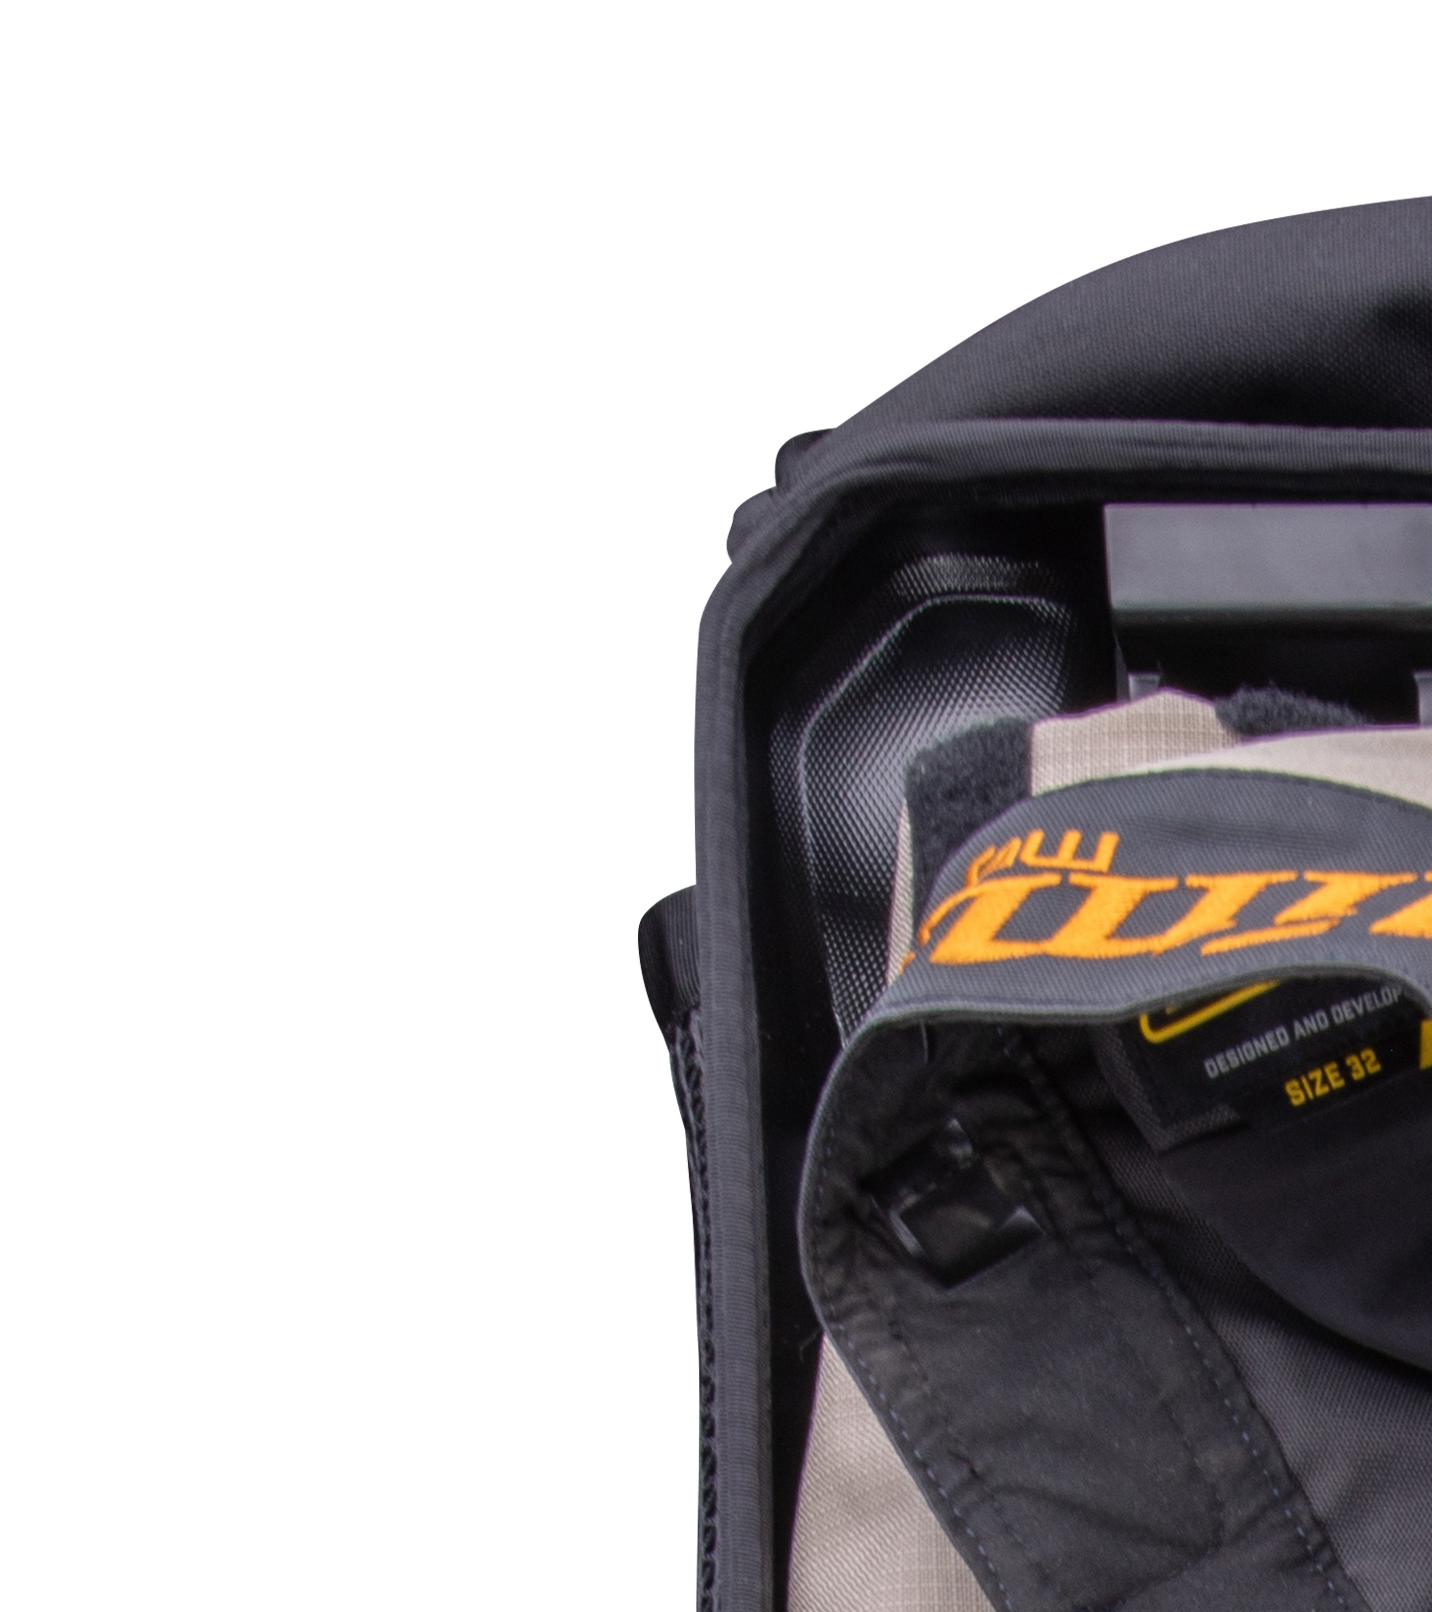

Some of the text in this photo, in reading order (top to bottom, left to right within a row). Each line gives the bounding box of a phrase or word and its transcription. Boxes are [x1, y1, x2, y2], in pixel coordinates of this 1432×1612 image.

[1204, 1028, 1291, 1080] DESIGNED
[1292, 1009, 1329, 1042] AND
[1284, 1046, 1382, 1108] SIZE 32
